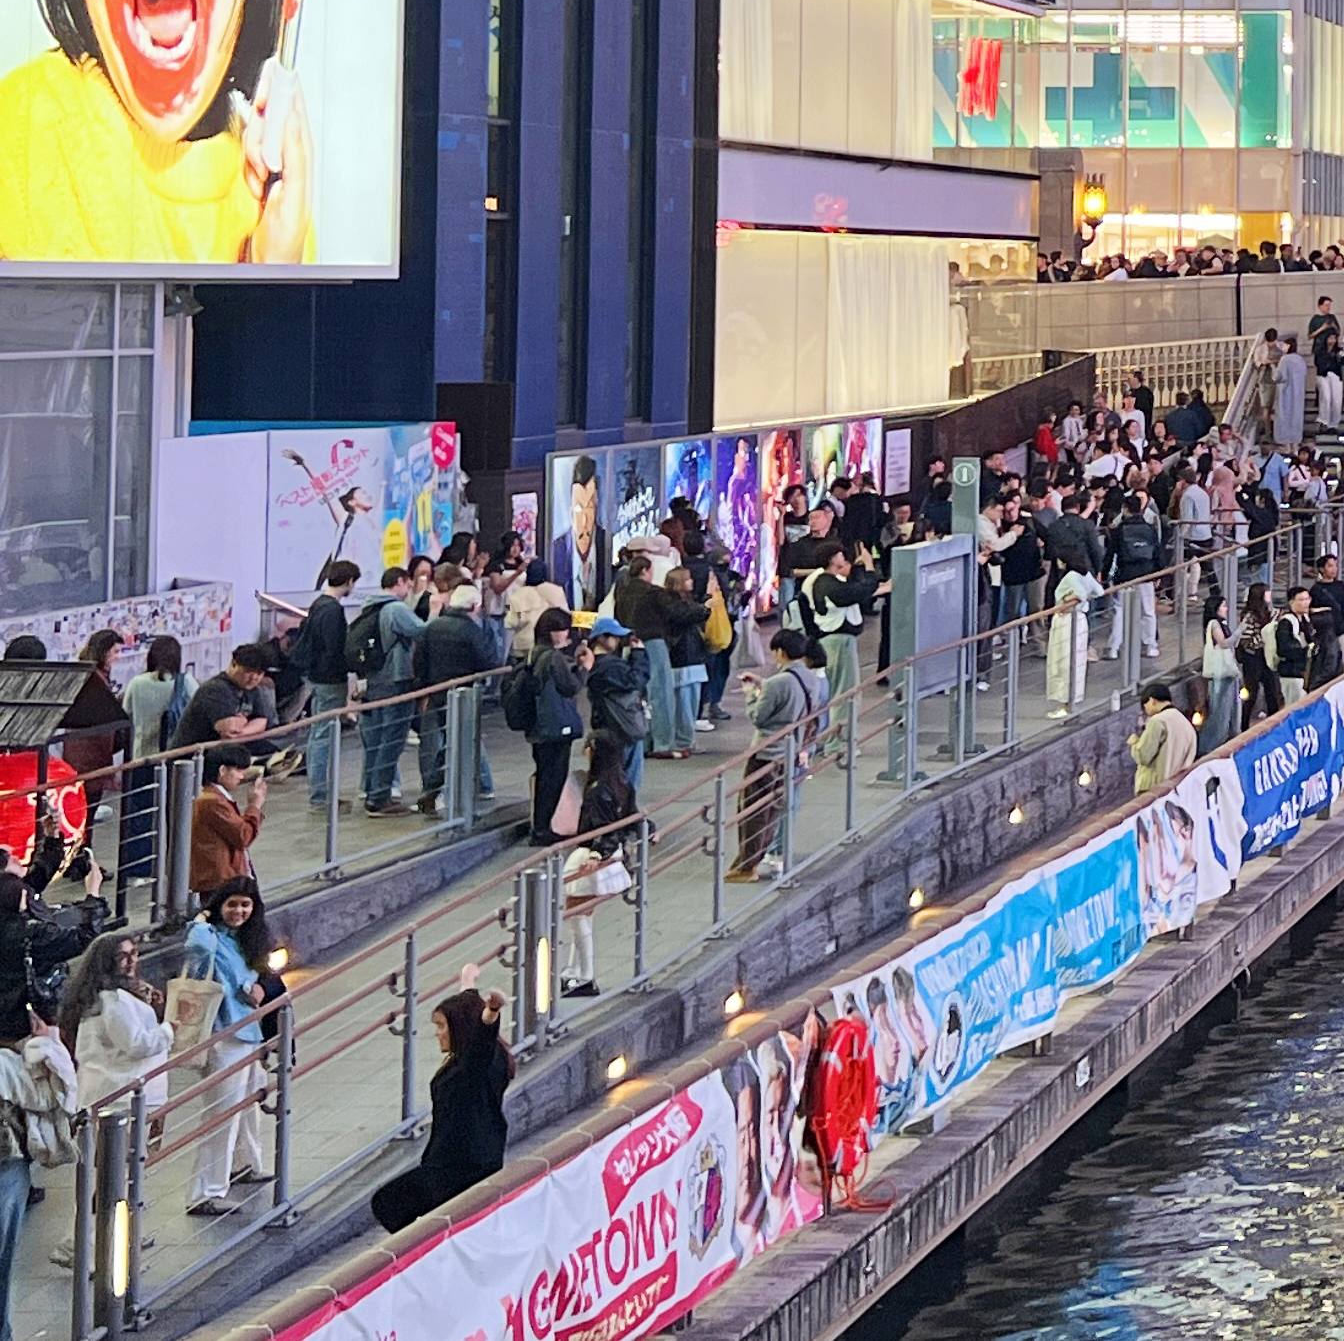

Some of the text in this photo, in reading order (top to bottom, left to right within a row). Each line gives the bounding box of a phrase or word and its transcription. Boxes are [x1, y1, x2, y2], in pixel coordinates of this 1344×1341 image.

[614, 1103, 692, 1185] セレッソ大阪
